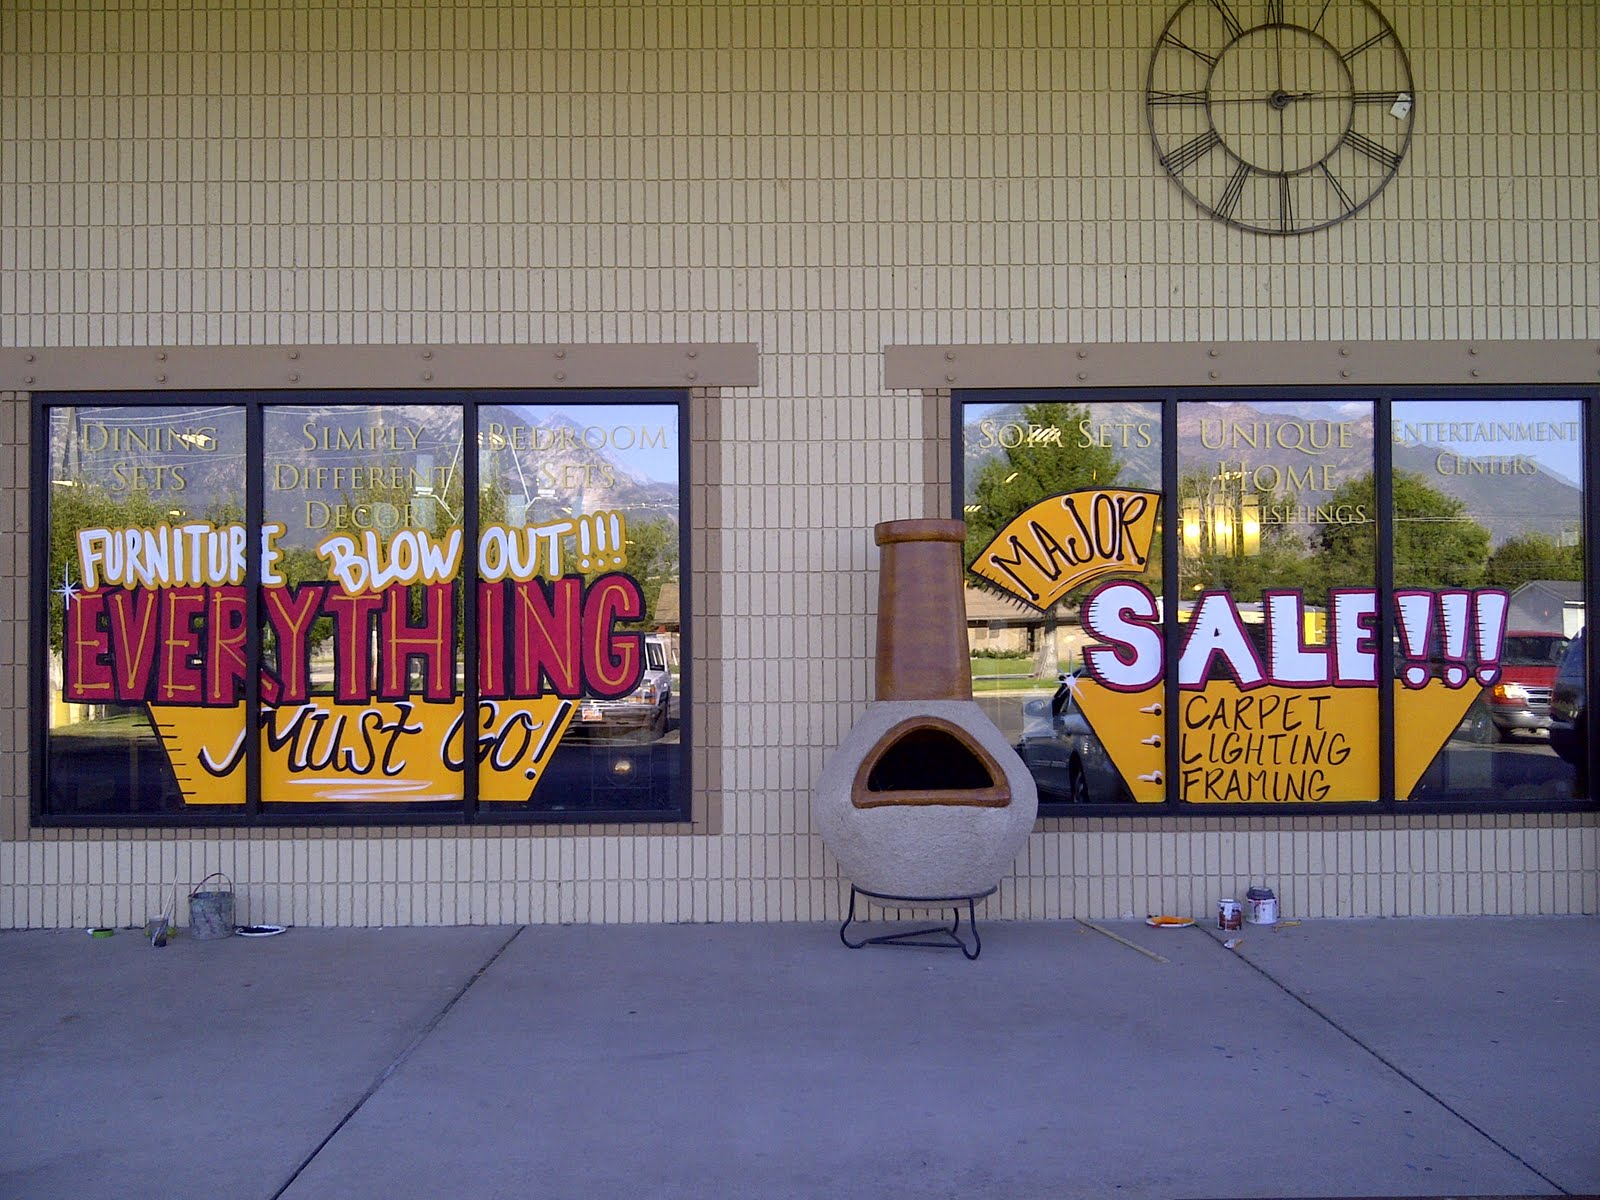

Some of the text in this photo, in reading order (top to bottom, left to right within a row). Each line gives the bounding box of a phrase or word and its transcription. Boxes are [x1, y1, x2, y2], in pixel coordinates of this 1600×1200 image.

[82, 423, 218, 452] DINING
[302, 422, 426, 451] SIMPLY
[489, 422, 668, 450] BEDROOM
[978, 419, 1152, 449] SOFA SETS
[1201, 419, 1354, 455] UNIQUE
[1392, 419, 1579, 443] ENTERTAINMENT
[112, 461, 187, 491] SETS
[274, 463, 453, 490] DIFFERENT
[540, 462, 616, 489] SETS
[1218, 460, 1339, 492] HOME
[1435, 451, 1538, 475] CENTERS
[304, 500, 421, 529] DECOR
[77, 521, 286, 592] FURNITURE
[317, 510, 628, 596] BLOW OUT!!!
[990, 493, 1148, 601] MAJOR
[62, 572, 646, 708] EVERYTHING
[1185, 694, 1332, 732] CARPET
[1181, 731, 1351, 765] LIGHTING
[1182, 767, 1331, 802] FRAMING
